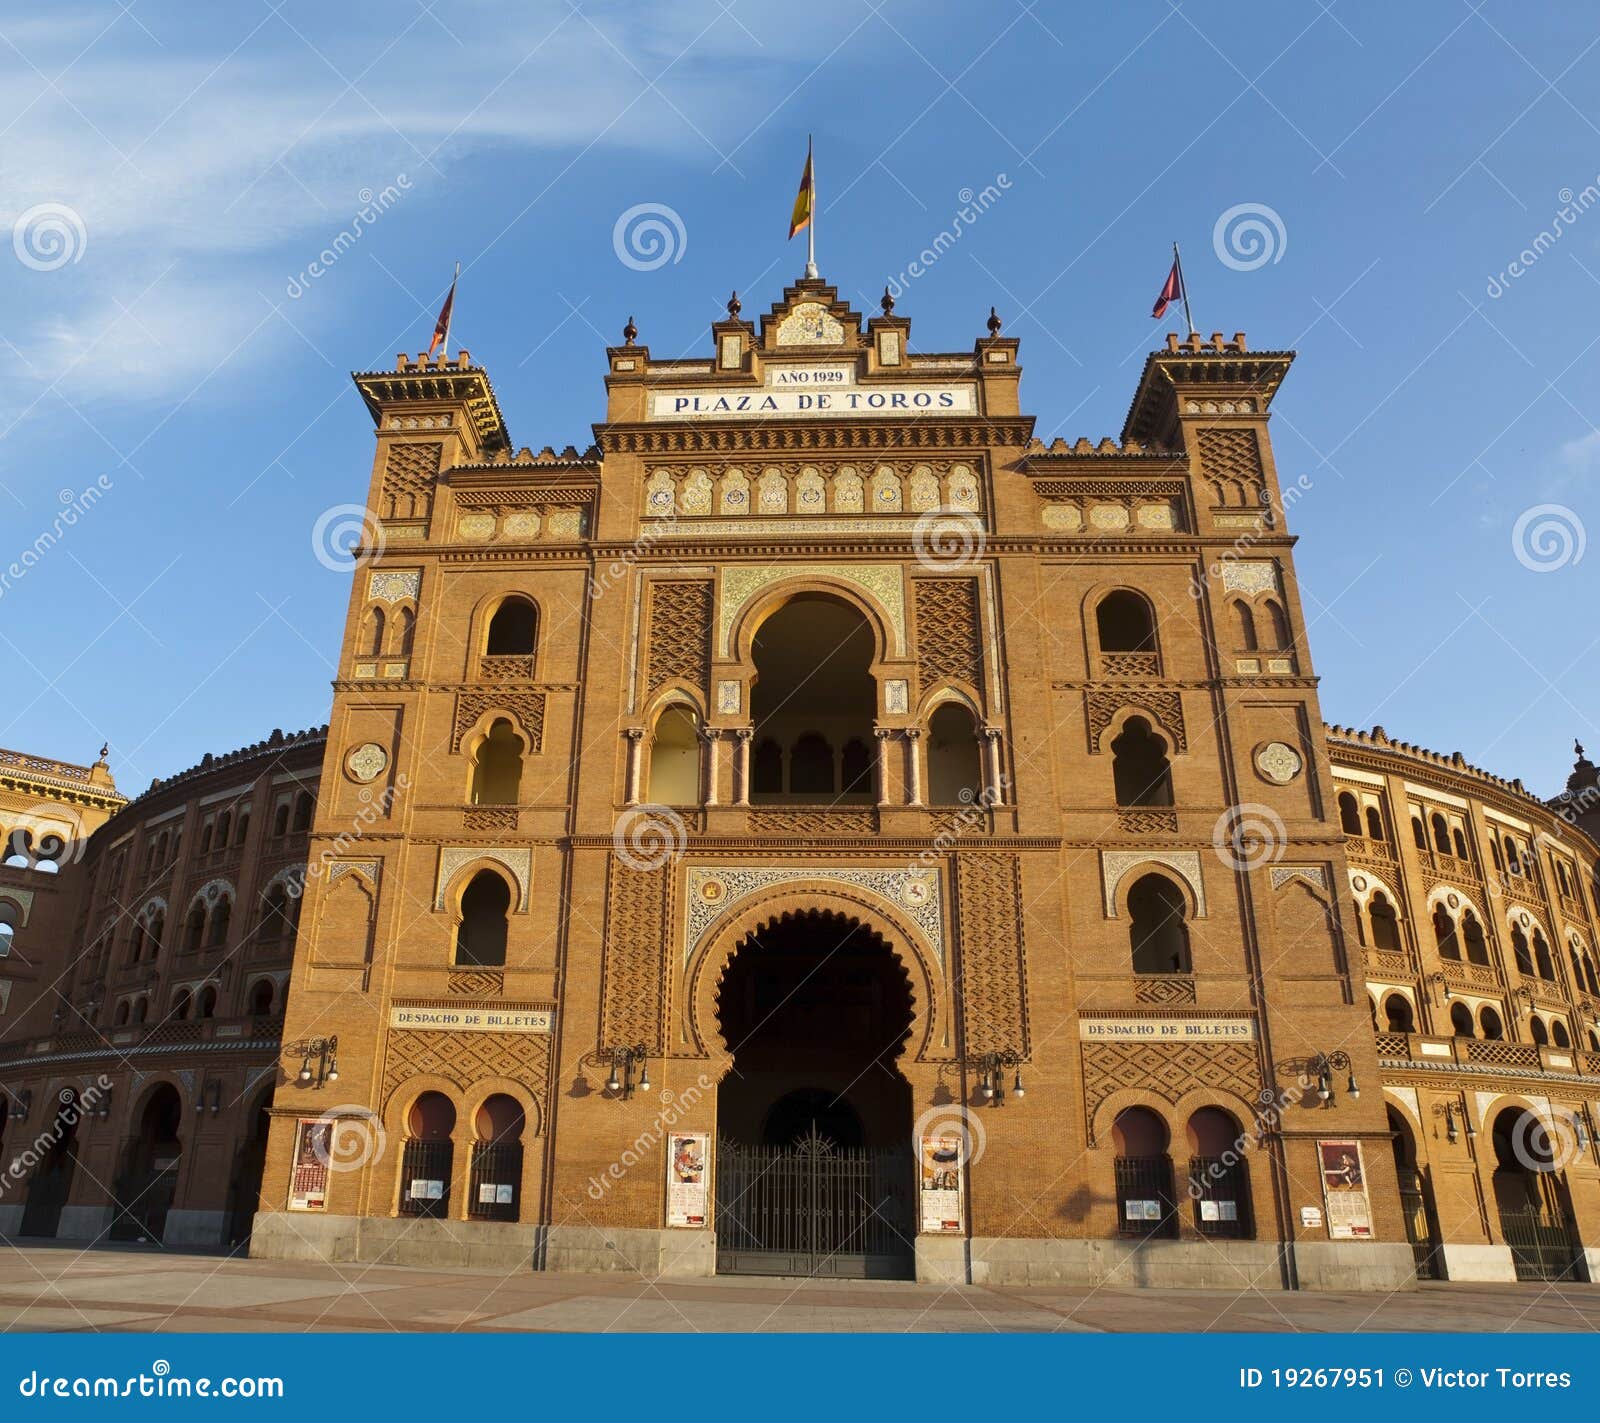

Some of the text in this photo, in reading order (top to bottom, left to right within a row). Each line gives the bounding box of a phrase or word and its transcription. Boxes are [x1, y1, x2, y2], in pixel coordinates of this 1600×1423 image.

[777, 370, 844, 384] AÑO 1929
[674, 391, 955, 413] PLAZA DE TOROS
[398, 1013, 547, 1026] DESPACHO DE BILLETES
[1088, 1025, 1248, 1035] DESPACHO DE BILLETES
